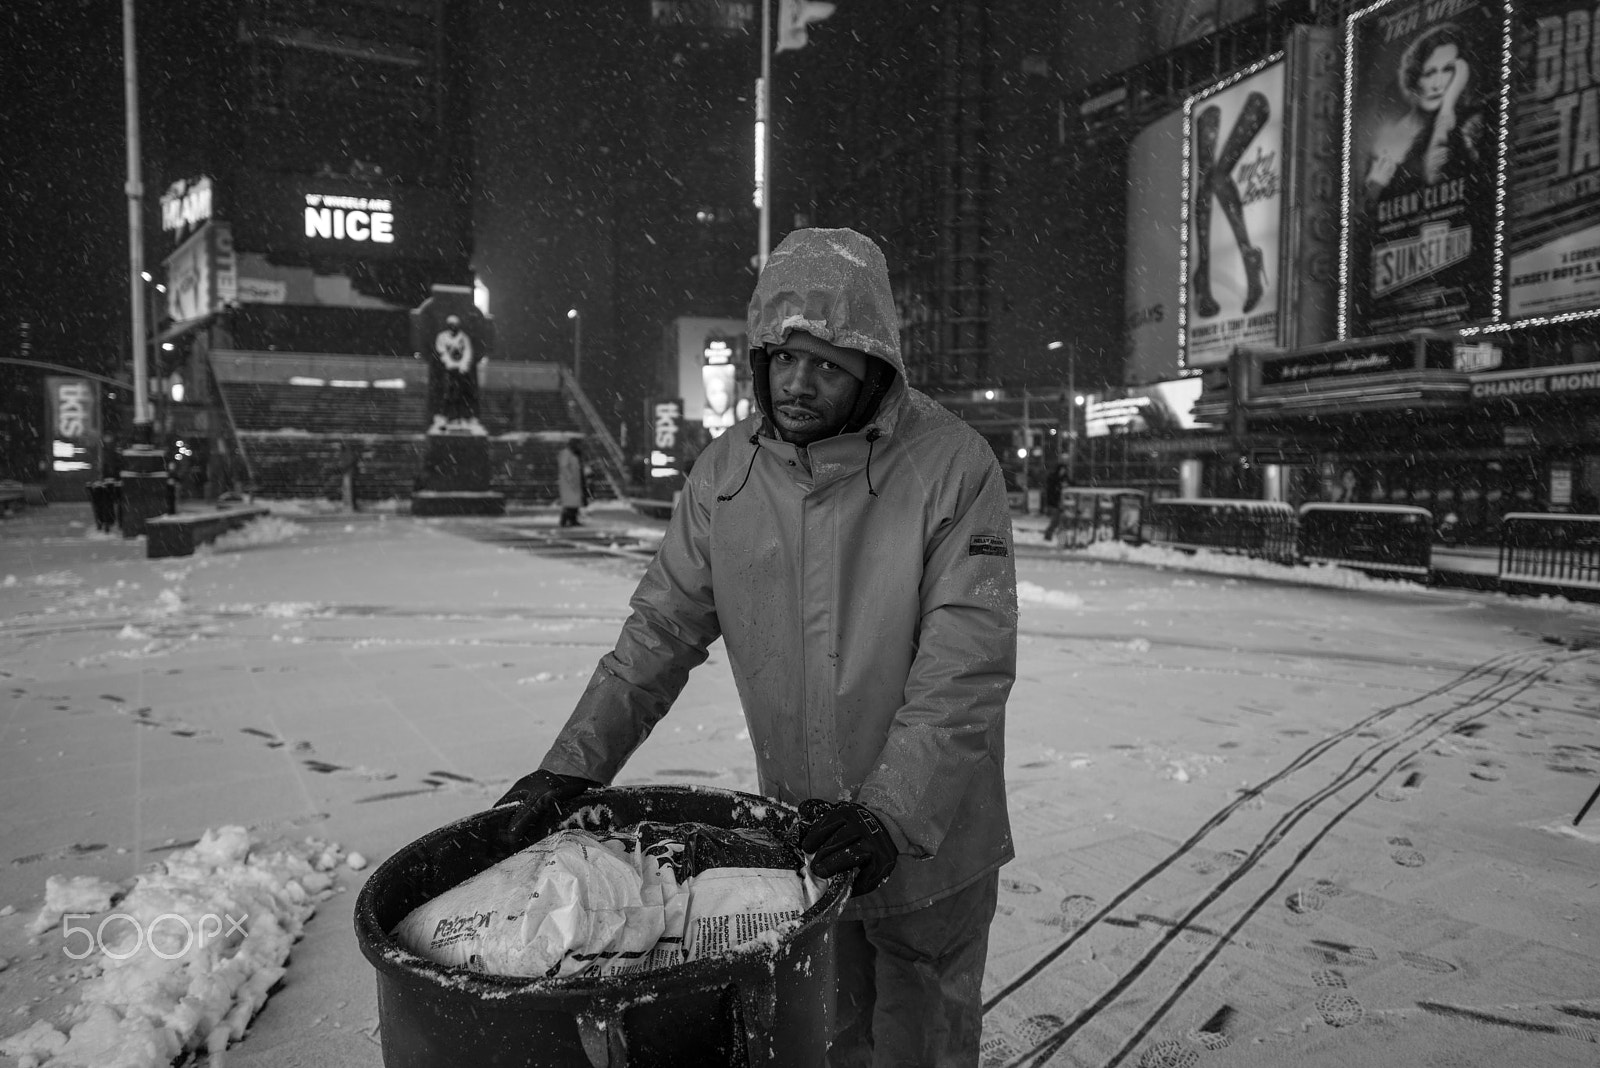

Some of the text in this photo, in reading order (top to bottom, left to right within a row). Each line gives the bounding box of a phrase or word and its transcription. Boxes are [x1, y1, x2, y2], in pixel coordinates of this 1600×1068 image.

[1378, 192, 1418, 222] GLENN
[1424, 177, 1465, 209] CLOSE
[305, 206, 394, 243] NICE
[1382, 239, 1442, 286] SUNSET
[1512, 271, 1549, 287] JERSEY
[1552, 264, 1583, 280] BOYS
[1472, 371, 1600, 398] CHANGE MON
[60, 384, 92, 437] tkts
[655, 402, 679, 449] tkts
